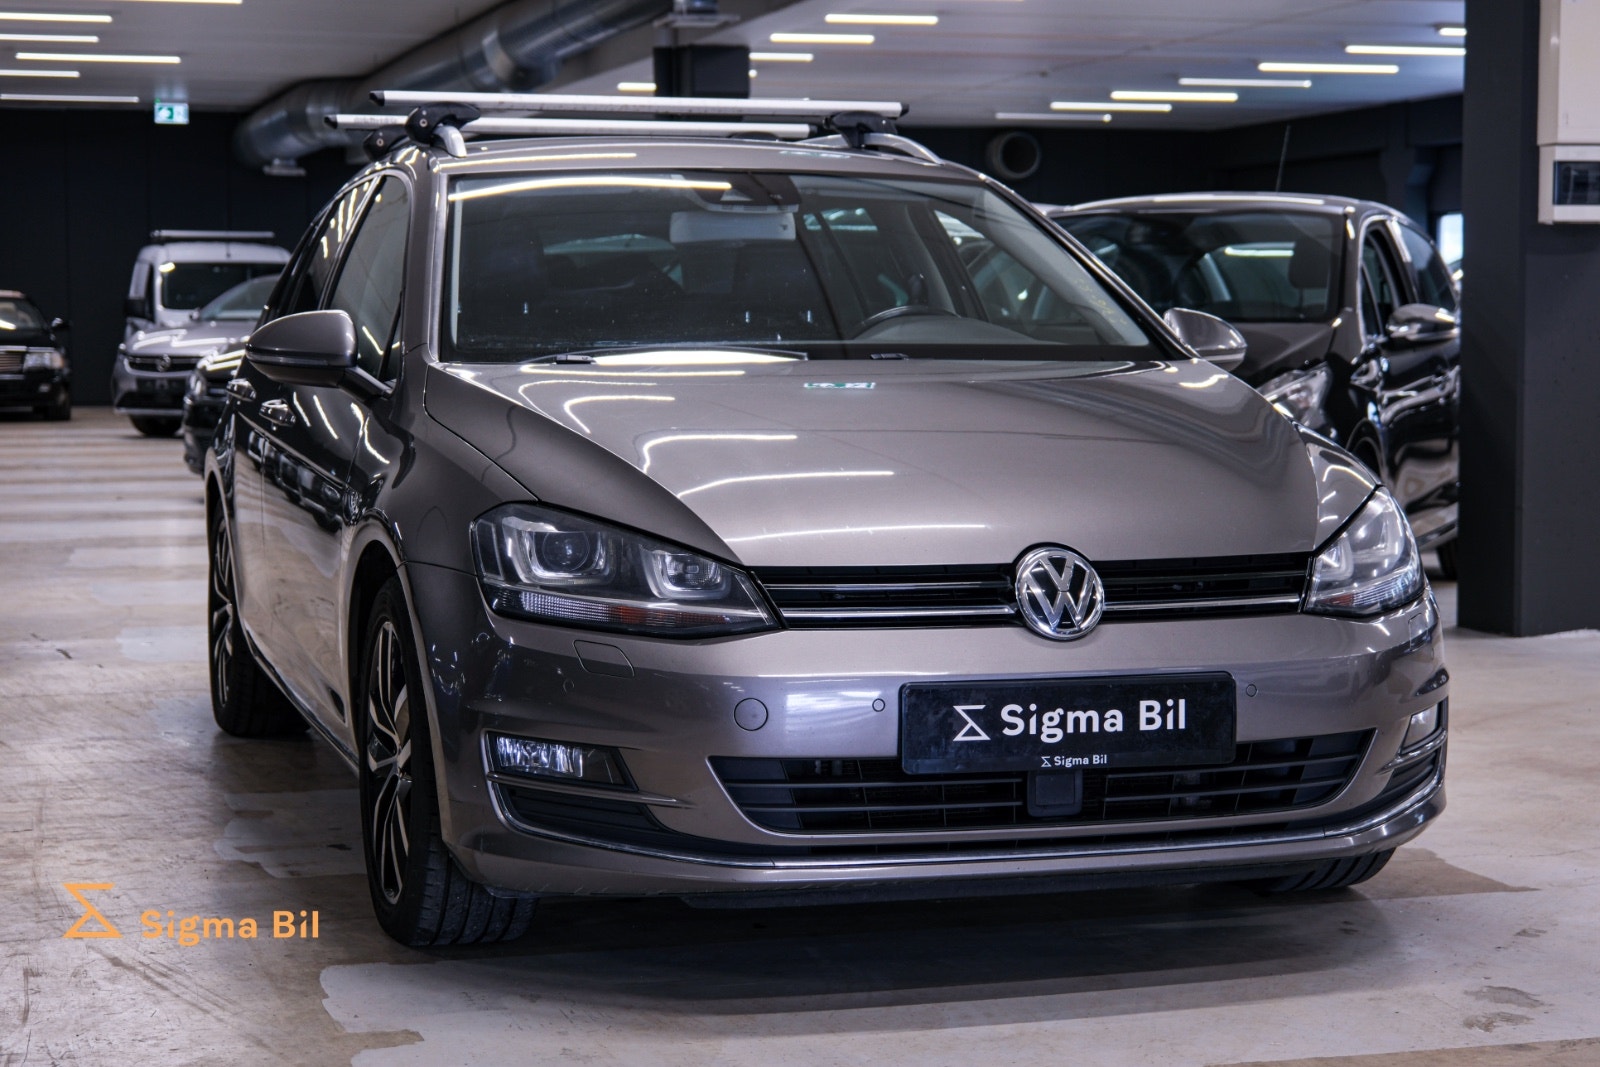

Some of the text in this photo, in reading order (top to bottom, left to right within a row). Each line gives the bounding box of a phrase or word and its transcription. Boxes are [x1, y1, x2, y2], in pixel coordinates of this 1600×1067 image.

[1000, 698, 1186, 744] Sigma Bil
[1053, 754, 1108, 768] Sigma Bil
